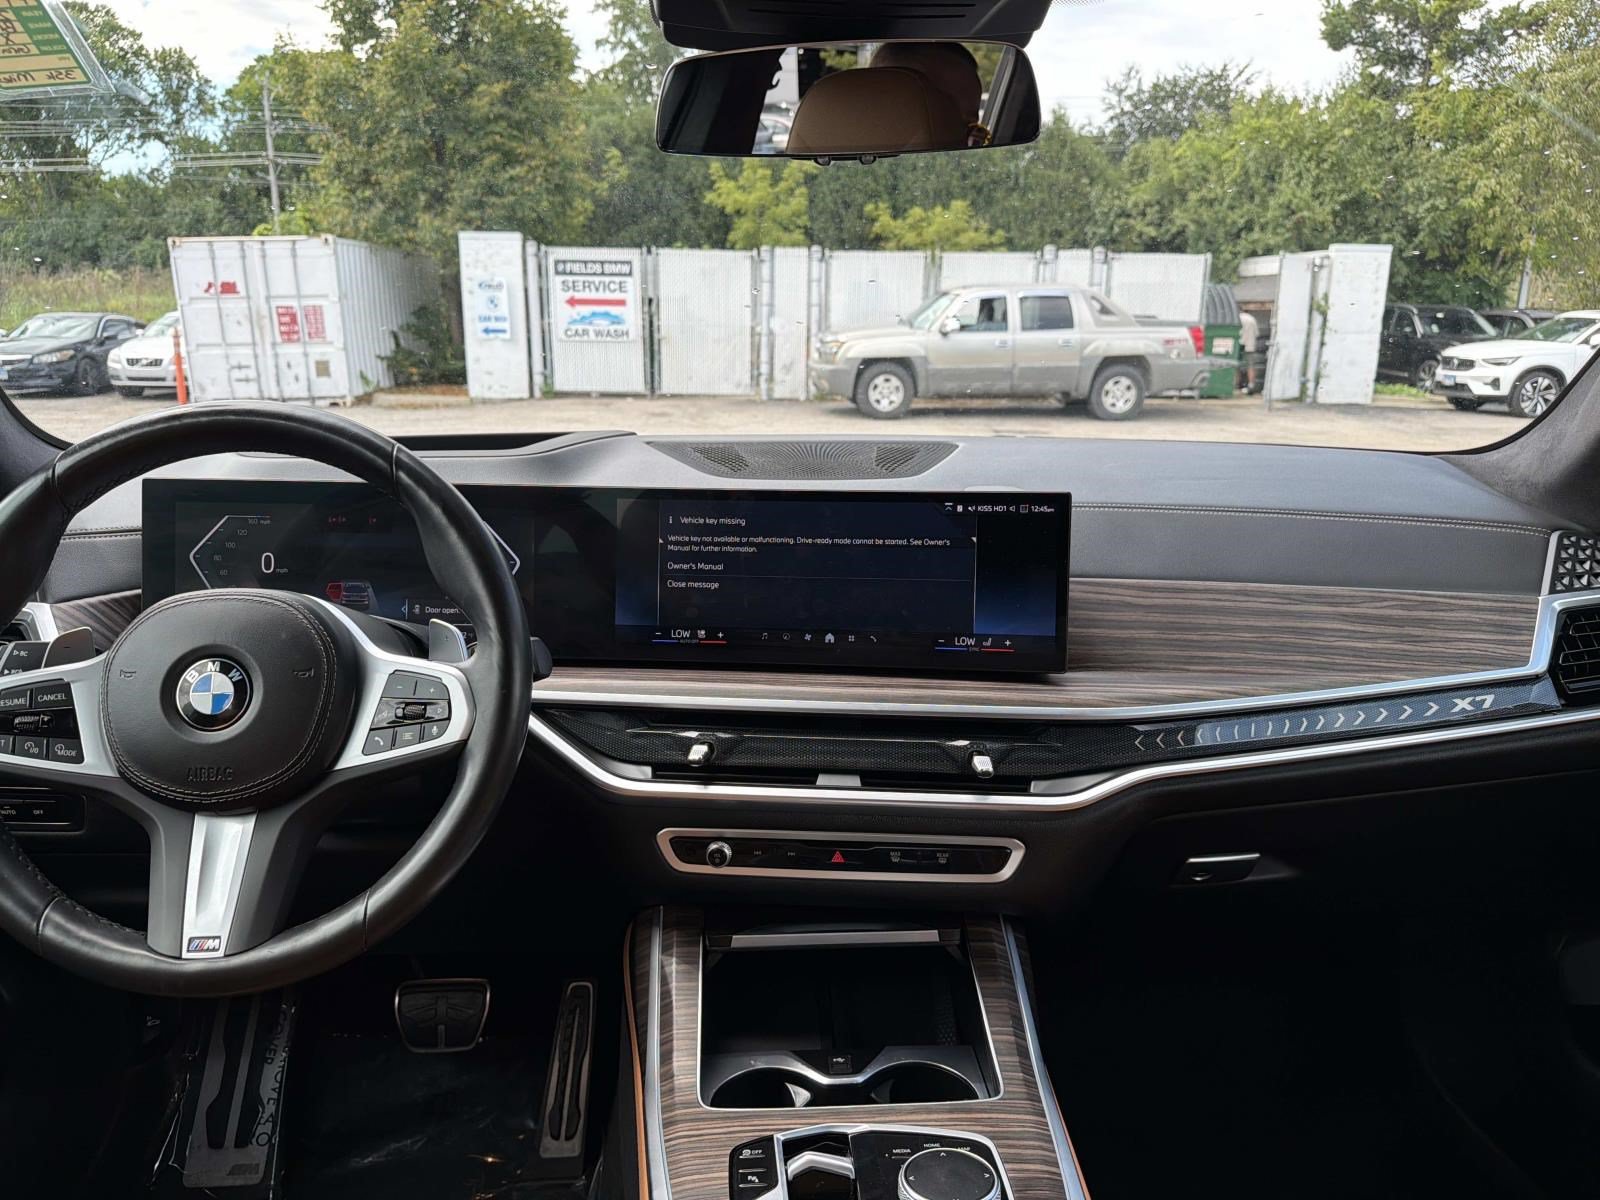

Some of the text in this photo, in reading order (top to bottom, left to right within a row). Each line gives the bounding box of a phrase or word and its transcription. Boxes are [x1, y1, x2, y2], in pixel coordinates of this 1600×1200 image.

[561, 279, 628, 294] SERVICE
[564, 328, 630, 339] CAR WASH
[680, 515, 746, 527] Vehicle key missing
[667, 534, 690, 542] Vehicle
[690, 535, 701, 543] key
[713, 535, 740, 543] available
[748, 535, 796, 545] malfunctioning.
[796, 536, 832, 545] Drive-ready
[833, 536, 851, 544] mode
[852, 537, 874, 545] cannot
[874, 537, 884, 545] be
[909, 538, 922, 546] See
[923, 538, 951, 546] Owner's
[700, 544, 721, 552] further
[721, 545, 758, 553] information.
[261, 552, 275, 574] 0
[667, 561, 724, 570] Owner's Manual
[667, 580, 720, 590] Close message
[425, 605, 441, 614] Door
[671, 629, 691, 638] LOW
[954, 636, 976, 646] LOW
[185, 661, 244, 684] BMW
[0, 697, 27, 707] ESUME
[37, 692, 67, 702] CANCEL
[1450, 694, 1495, 713] X7
[57, 749, 77, 757] MODE
[185, 766, 233, 782] AIRBAG
